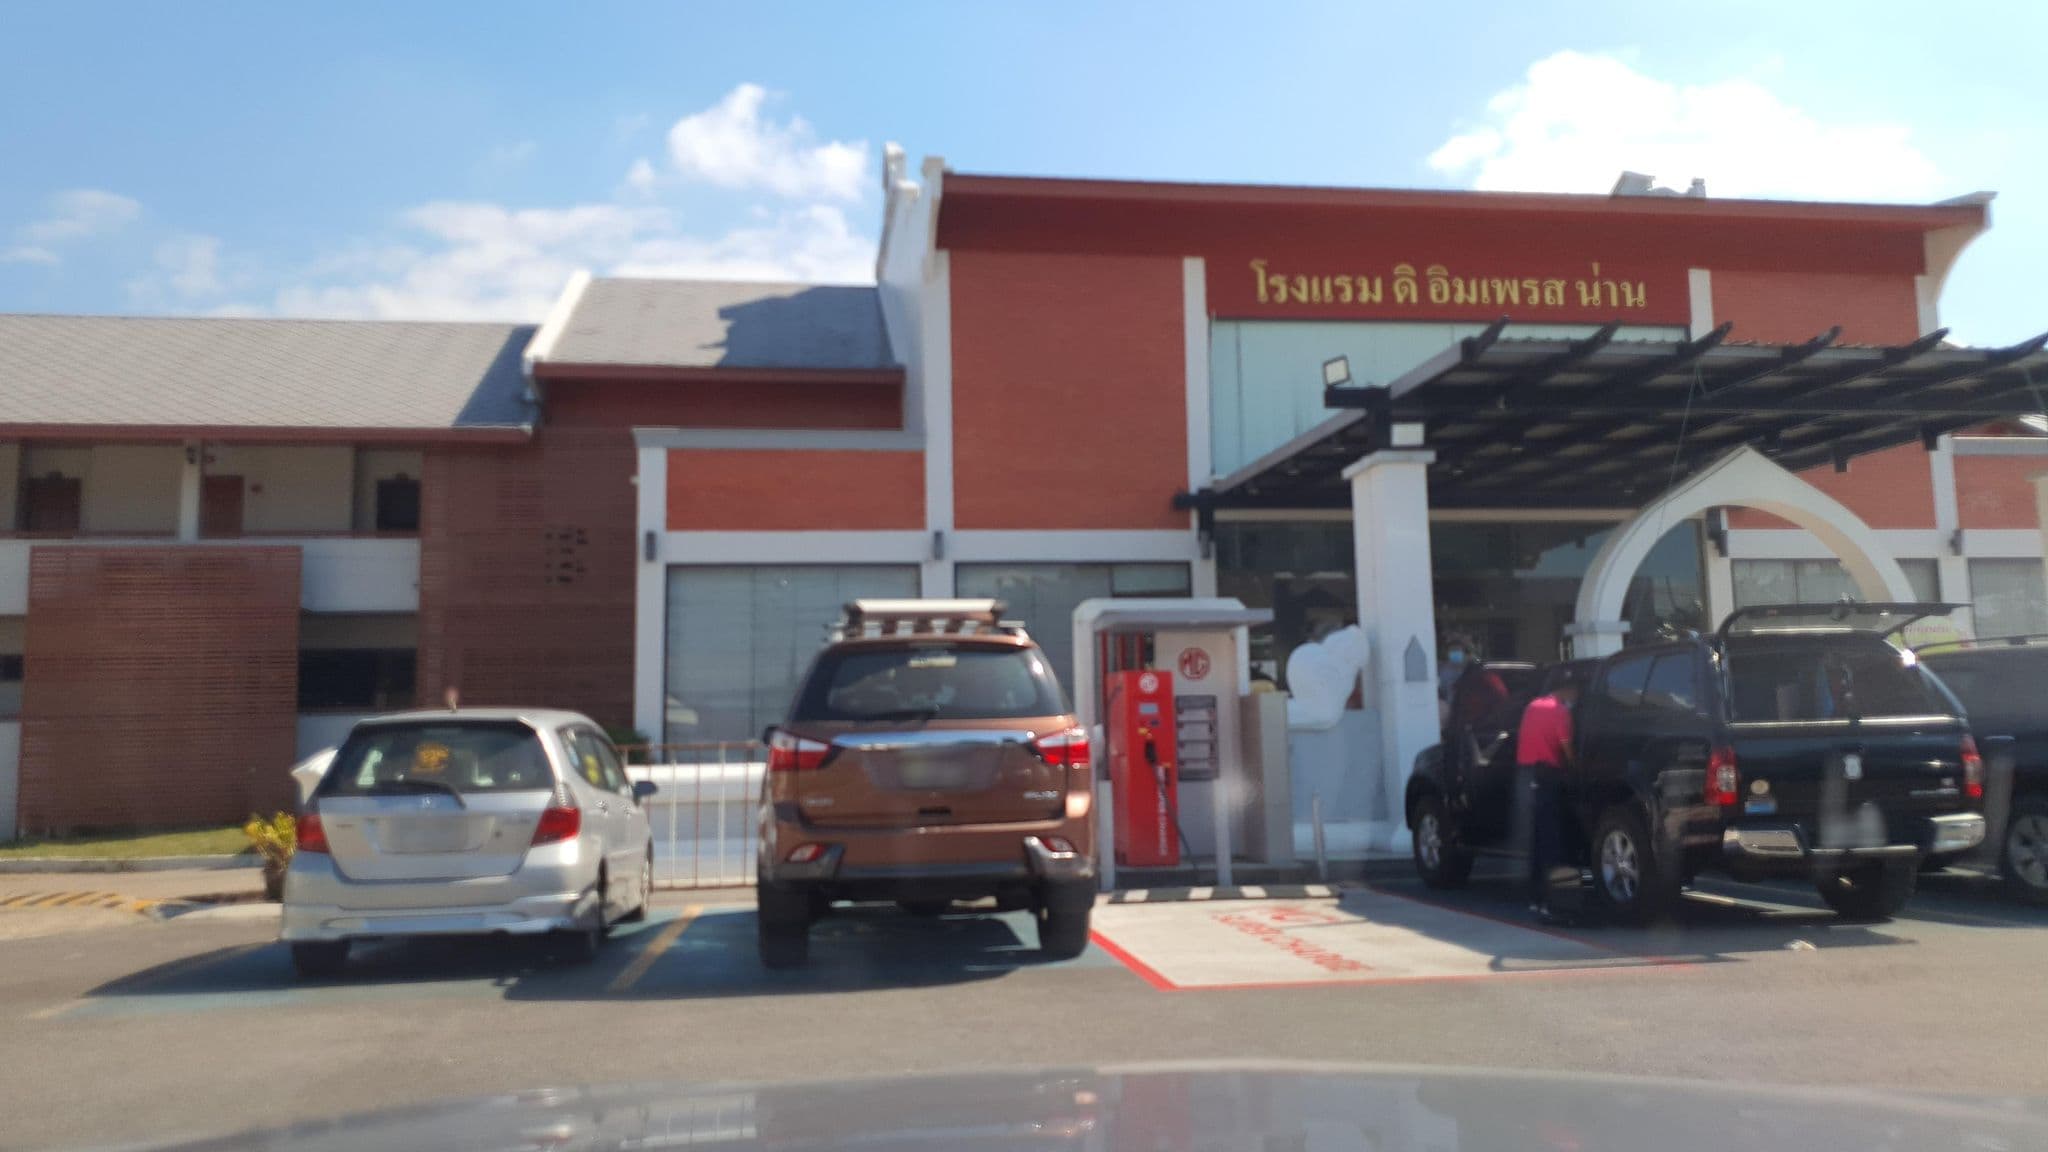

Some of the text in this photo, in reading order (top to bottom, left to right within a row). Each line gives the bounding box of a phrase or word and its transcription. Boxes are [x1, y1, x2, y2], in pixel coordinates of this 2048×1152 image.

[1250, 258, 1646, 307] โรงแรม ดิ อิมเพรส น่าน
[1179, 649, 1210, 680] MG
